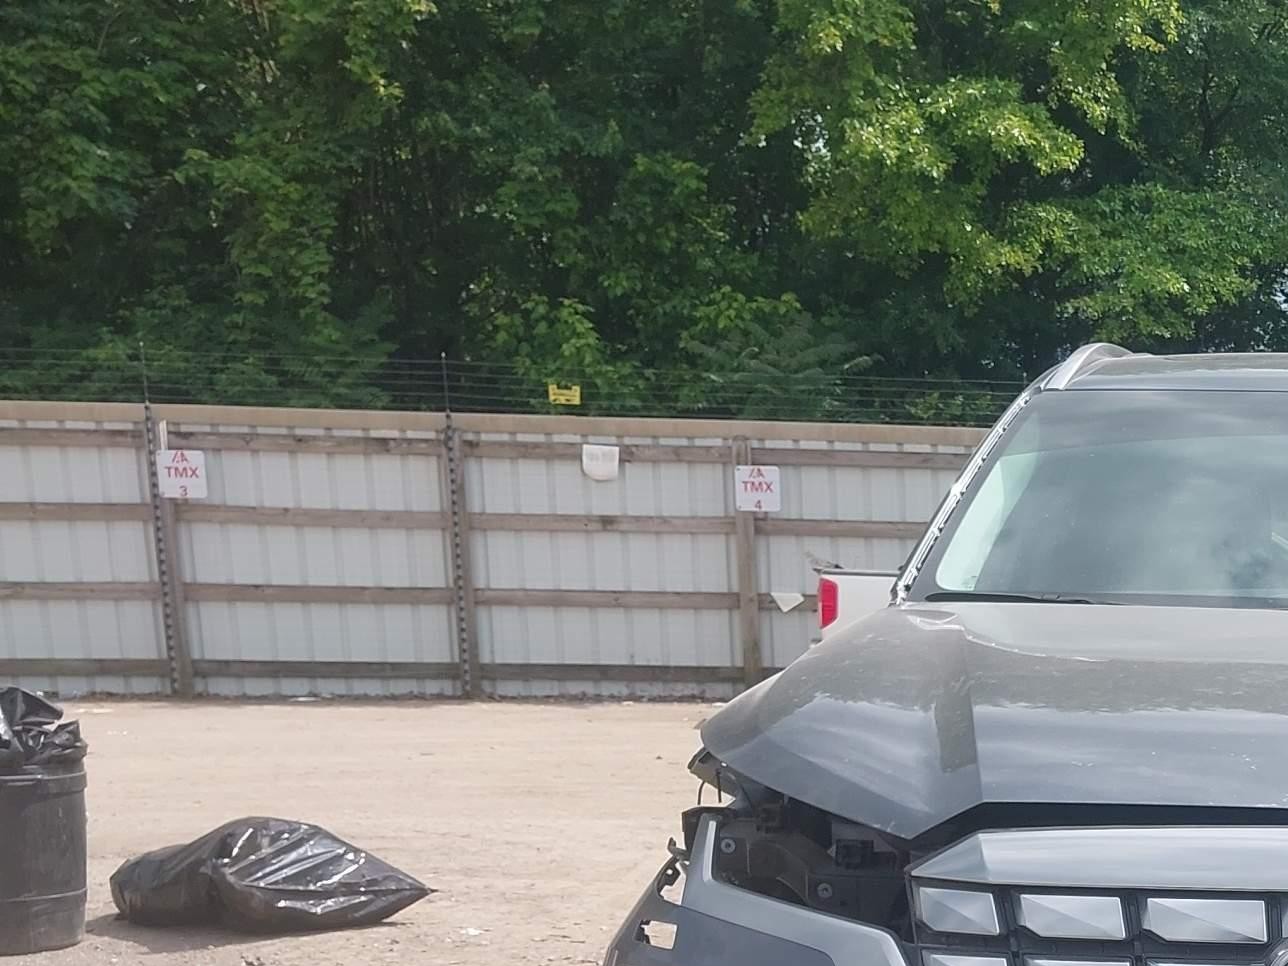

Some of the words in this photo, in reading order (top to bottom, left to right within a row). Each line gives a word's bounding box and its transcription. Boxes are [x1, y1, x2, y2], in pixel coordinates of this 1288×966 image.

[164, 466, 199, 479] TMX
[179, 485, 188, 497] 3
[742, 480, 774, 493] TMX
[754, 500, 762, 511] 4
